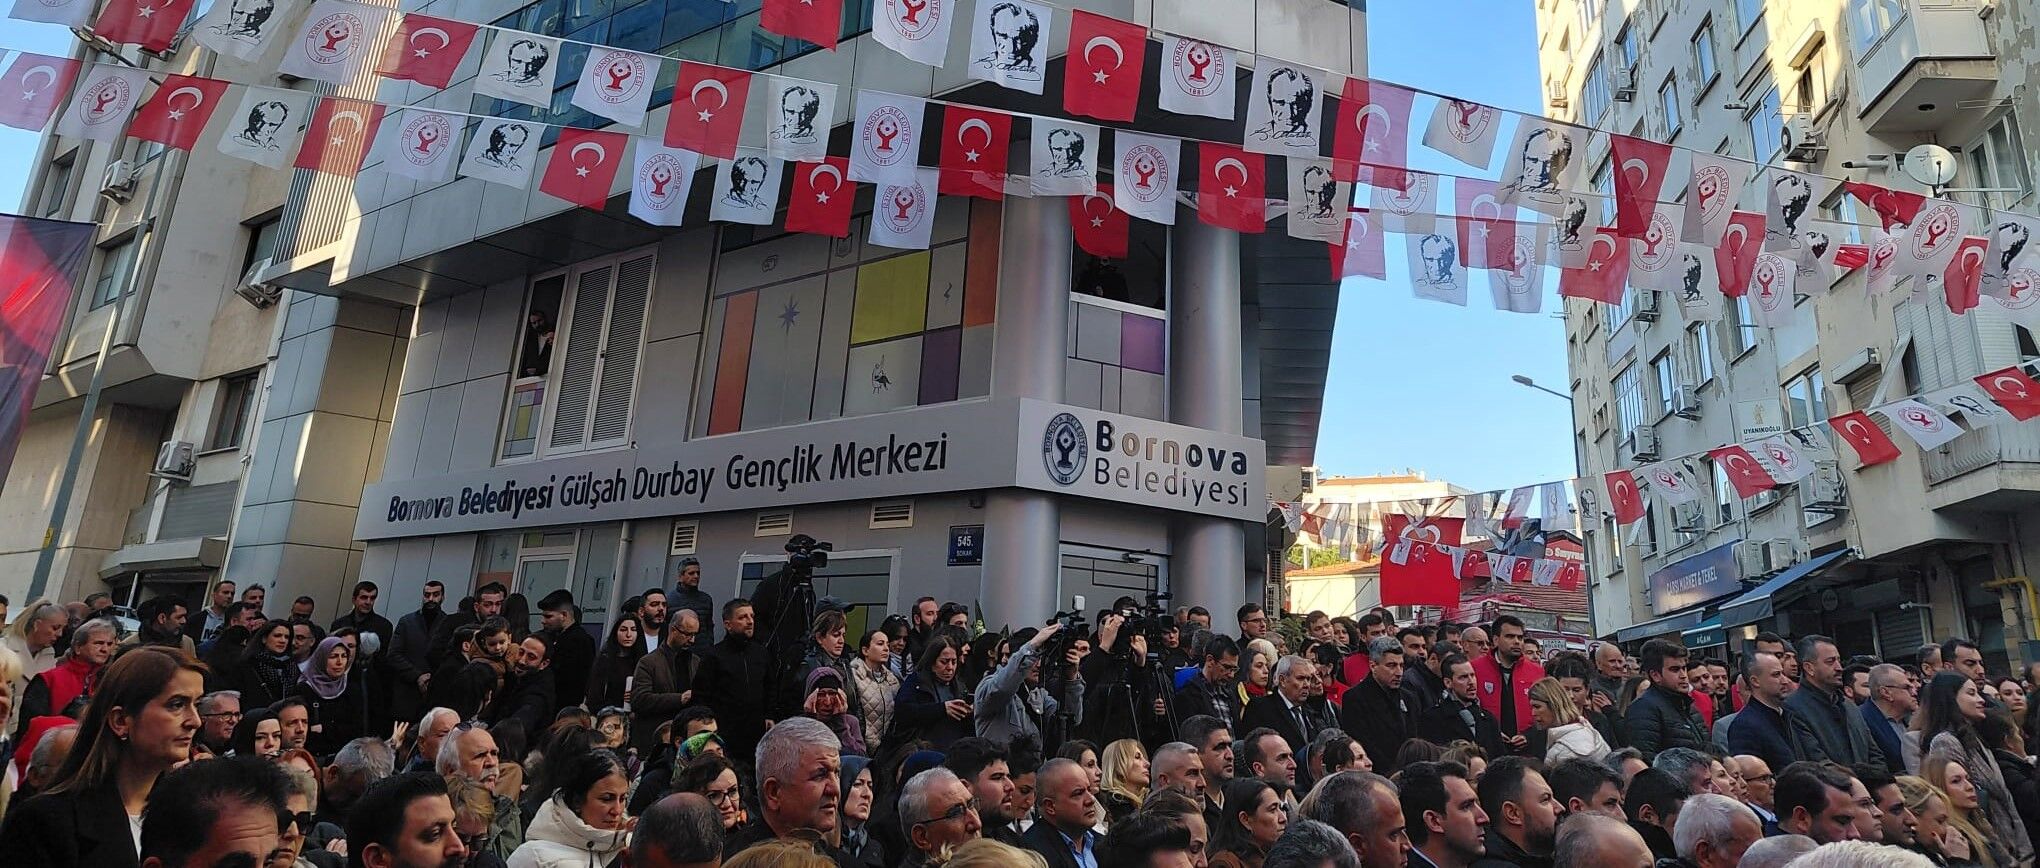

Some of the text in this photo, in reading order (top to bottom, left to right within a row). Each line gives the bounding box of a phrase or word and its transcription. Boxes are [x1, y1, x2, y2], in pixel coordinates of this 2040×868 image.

[1096, 420, 1247, 475] Bornova
[1743, 425, 1781, 434] UYANIKOĞLU
[387, 432, 948, 522] Bornova Belediyesi Gülşah Durbay Gençlik Merkezi
[1095, 458, 1247, 506] Belediyesi
